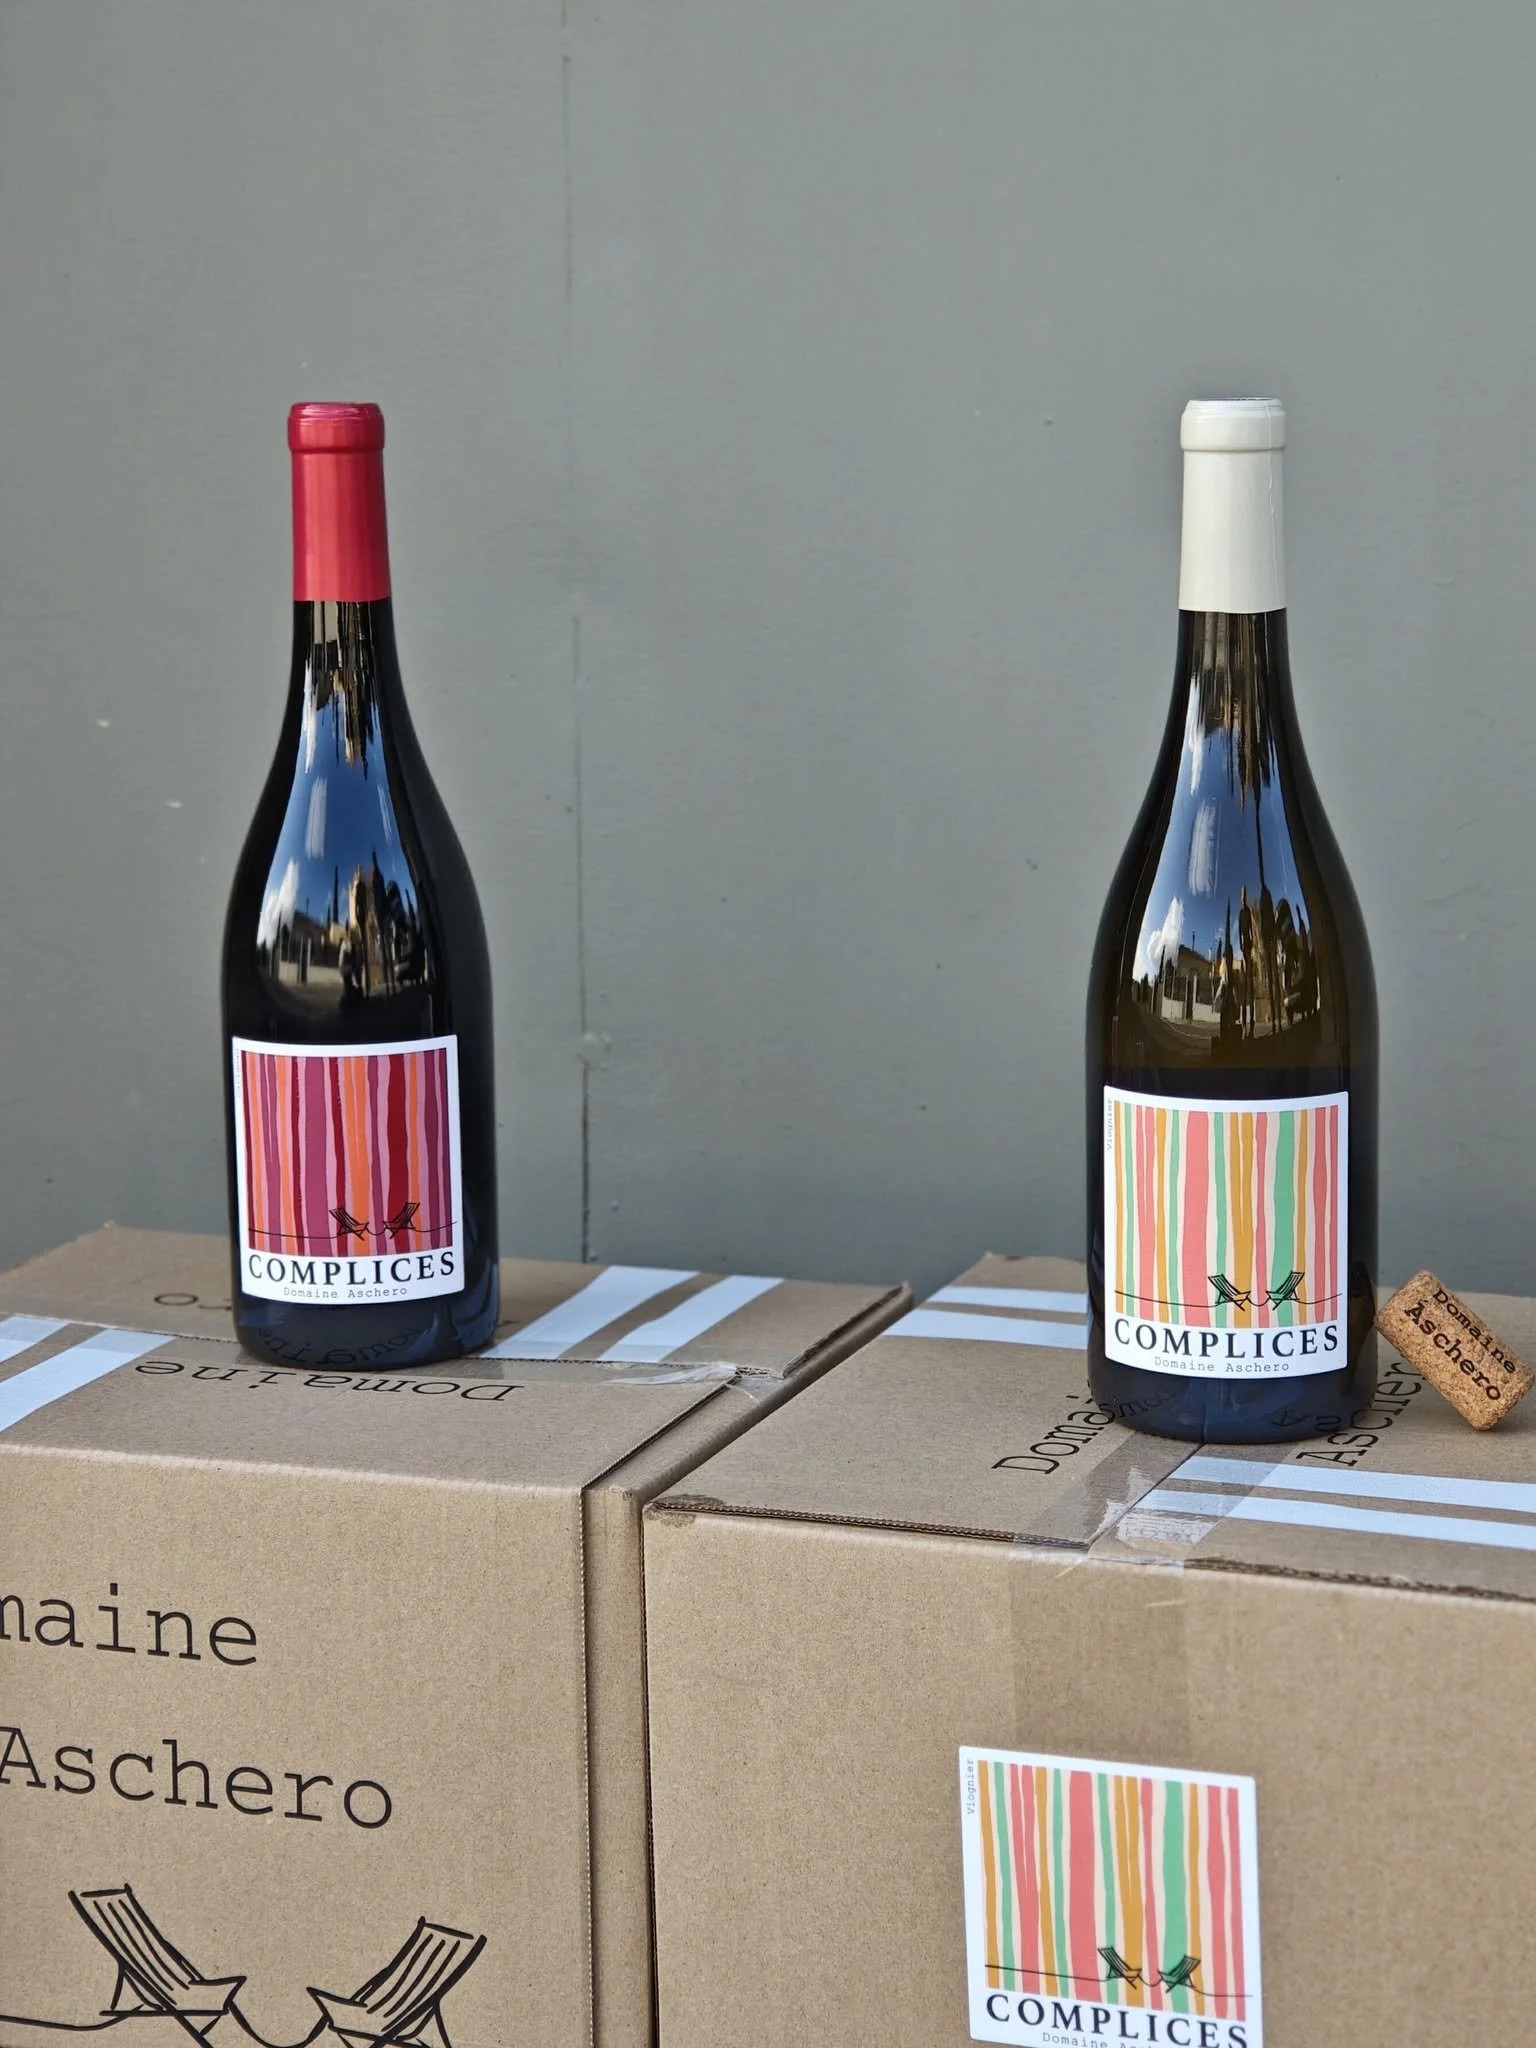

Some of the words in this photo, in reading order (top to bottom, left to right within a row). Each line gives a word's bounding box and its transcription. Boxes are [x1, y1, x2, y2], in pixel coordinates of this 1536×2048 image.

[249, 1251, 455, 1286] COMPLICES
[284, 1287, 338, 1299] Domaine
[347, 1287, 408, 1299] Aschero
[1114, 1318, 1339, 1359] COMPLICES
[1404, 1300, 1501, 1401] Aschero
[1433, 1287, 1516, 1374] Domaine
[135, 1361, 525, 1402] Domaine
[1154, 1356, 1215, 1372] Domaine
[1225, 1360, 1290, 1373] Aschero
[0, 1726, 393, 1830] Aschero
[965, 1758, 976, 1815] Viognier
[986, 1993, 1248, 2048] COMPLICES
[1042, 2032, 1108, 2048] Domaine
